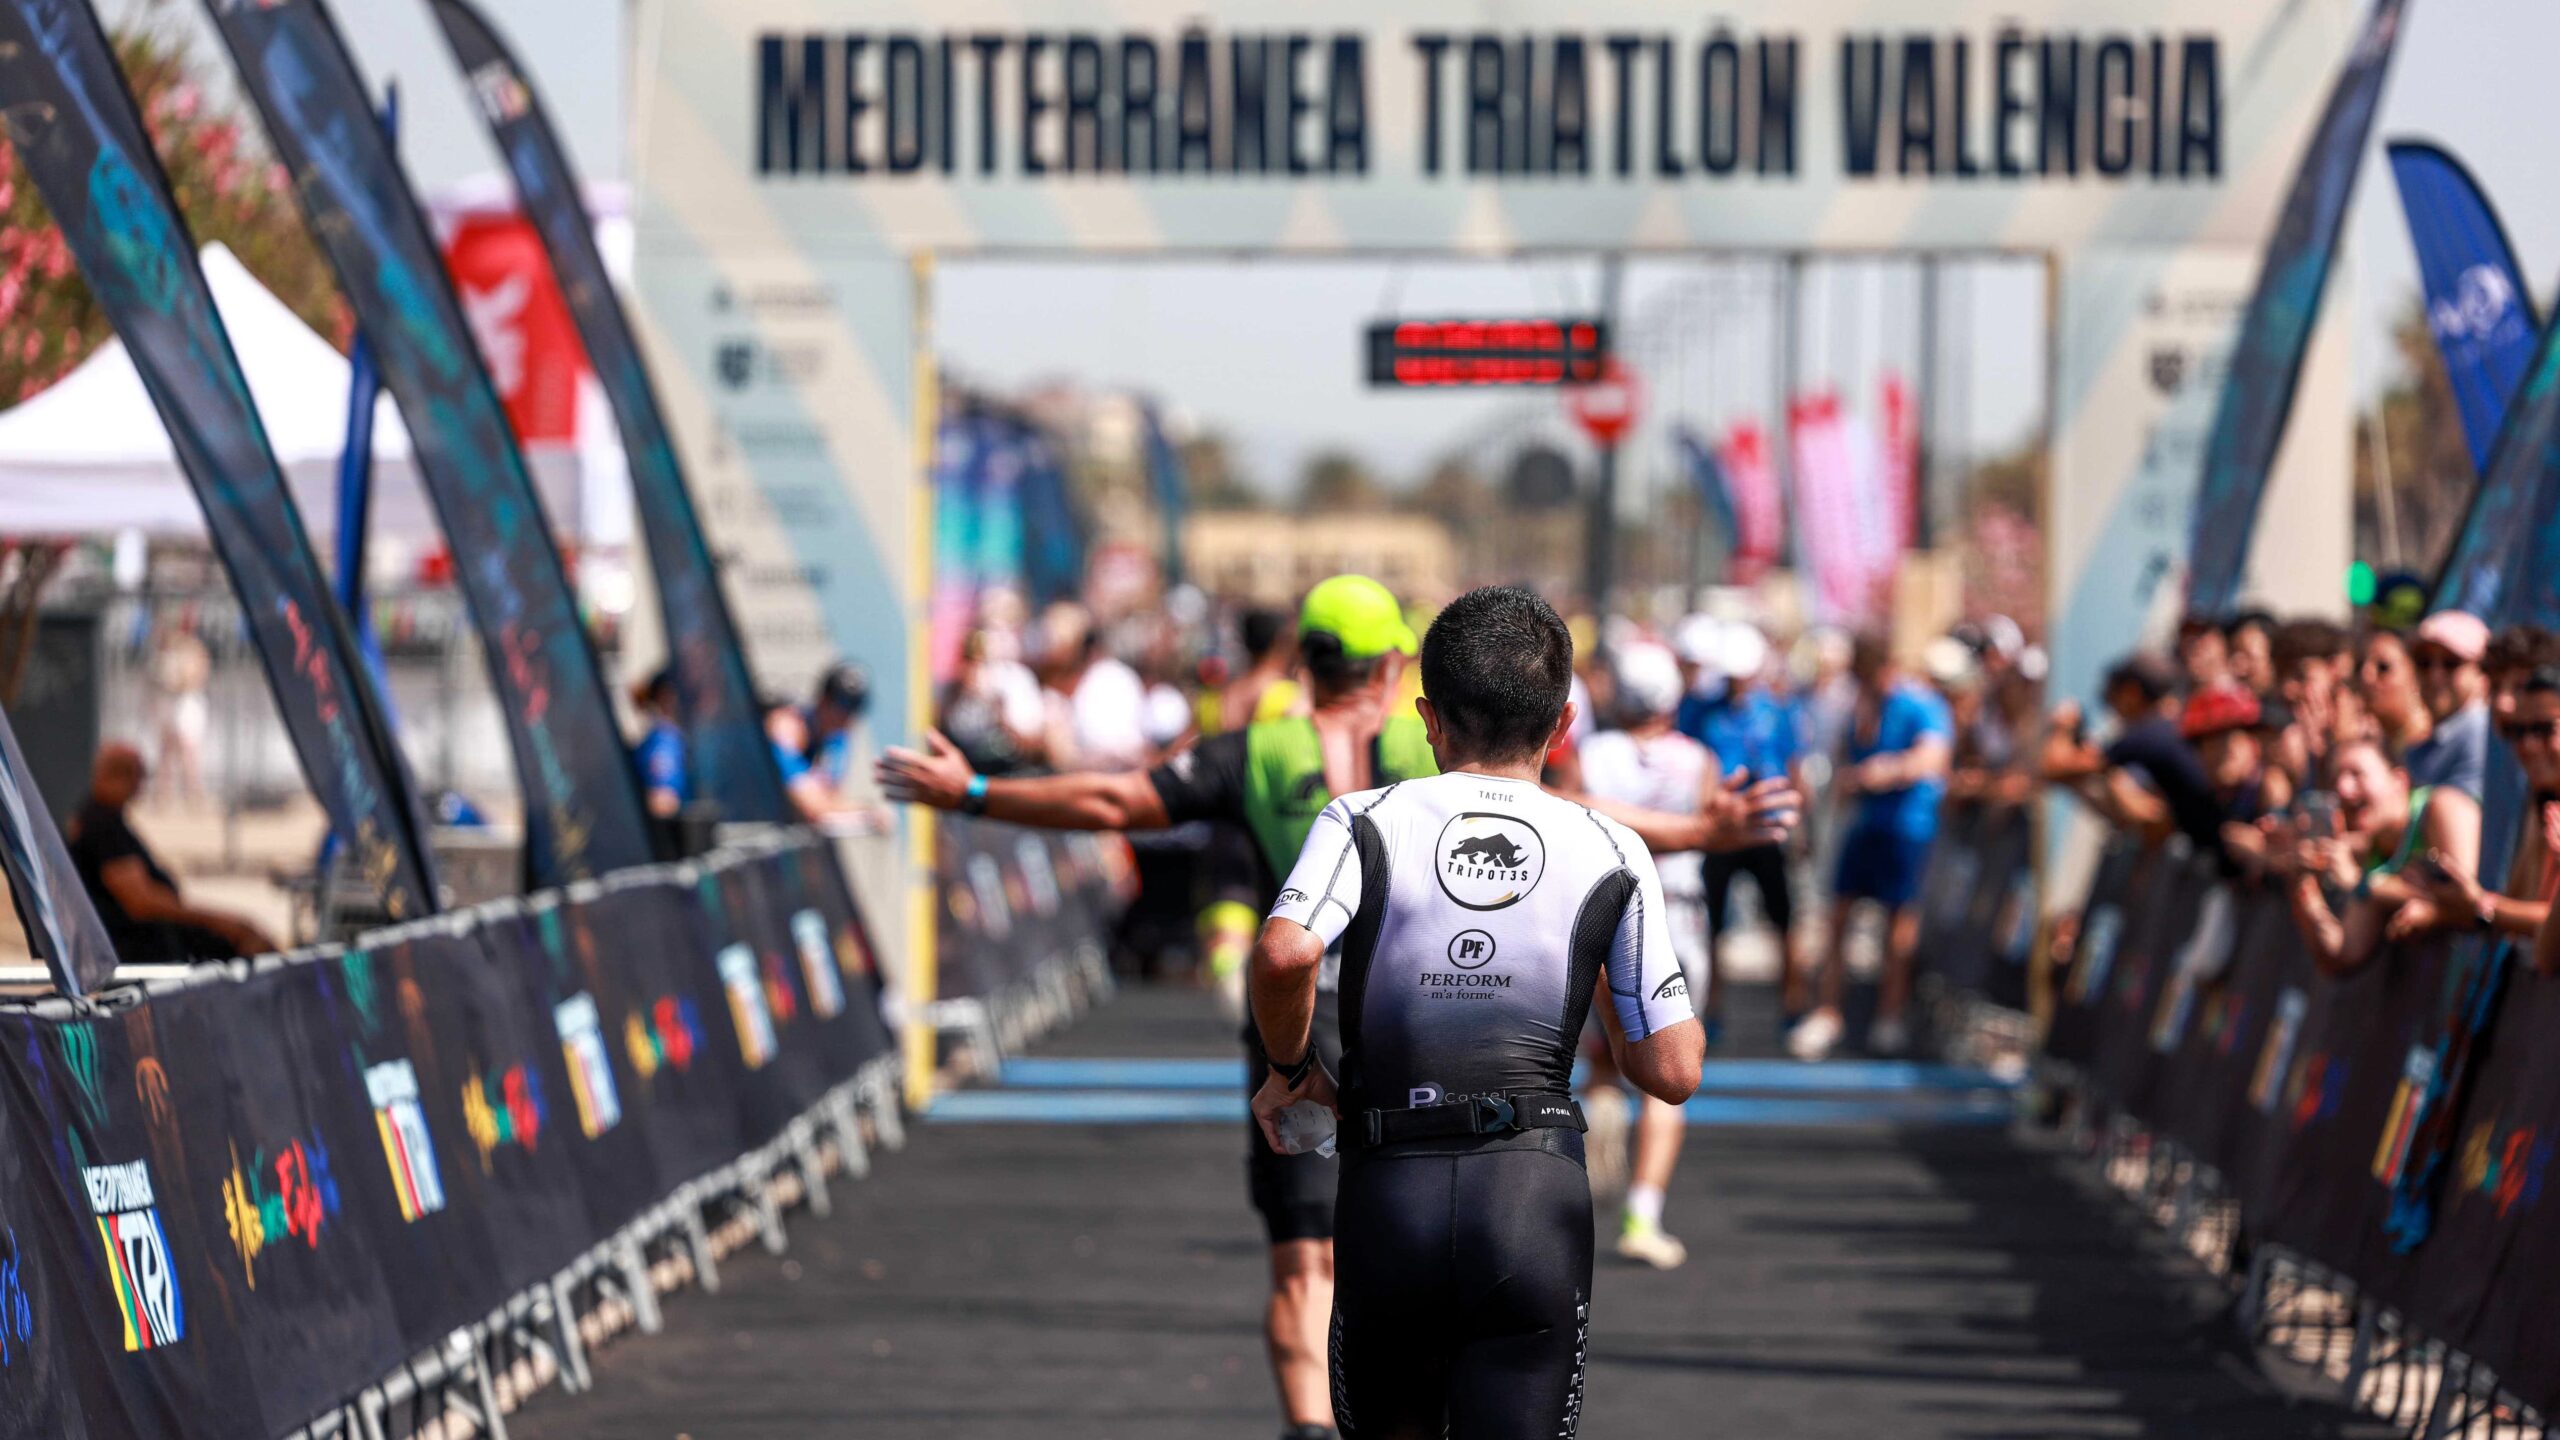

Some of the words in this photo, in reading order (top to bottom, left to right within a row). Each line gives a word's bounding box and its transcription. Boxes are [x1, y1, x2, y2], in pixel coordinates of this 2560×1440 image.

[1479, 790, 1514, 803] TACTIC
[1447, 861, 1528, 881] TRIPOT3S
[1458, 938, 1485, 959] PF
[1419, 972, 1513, 988] PERFORM
[1455, 988, 1496, 1000] formé
